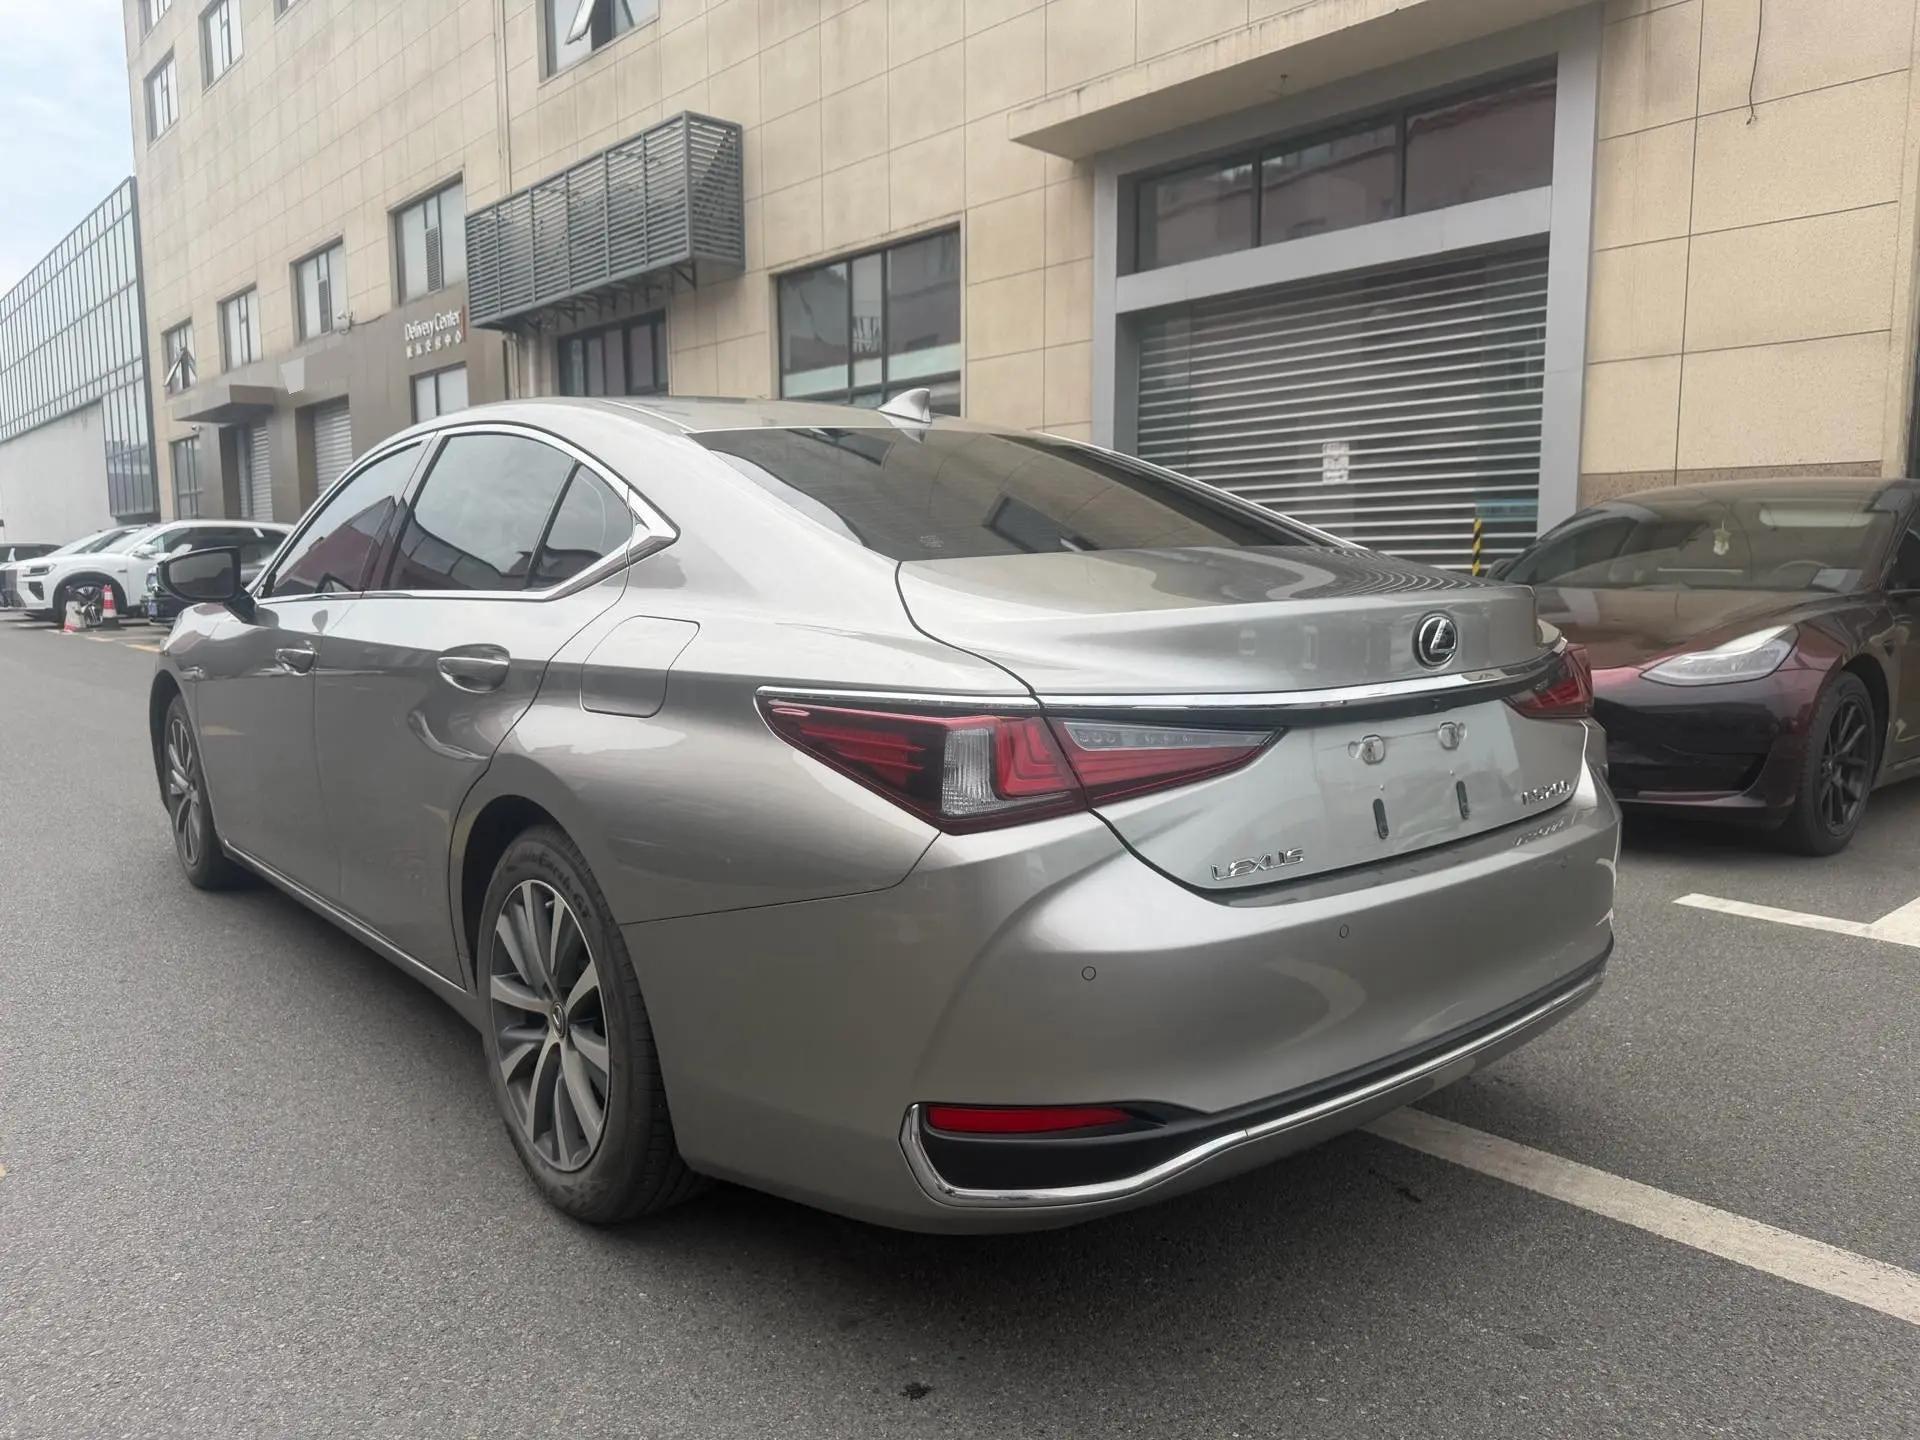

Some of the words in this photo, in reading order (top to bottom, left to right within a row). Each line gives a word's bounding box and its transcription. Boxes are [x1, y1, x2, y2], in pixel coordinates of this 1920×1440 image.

[404, 320, 434, 341] Delivery
[434, 310, 461, 332] Center
[1211, 847, 1304, 880] LEXUS
